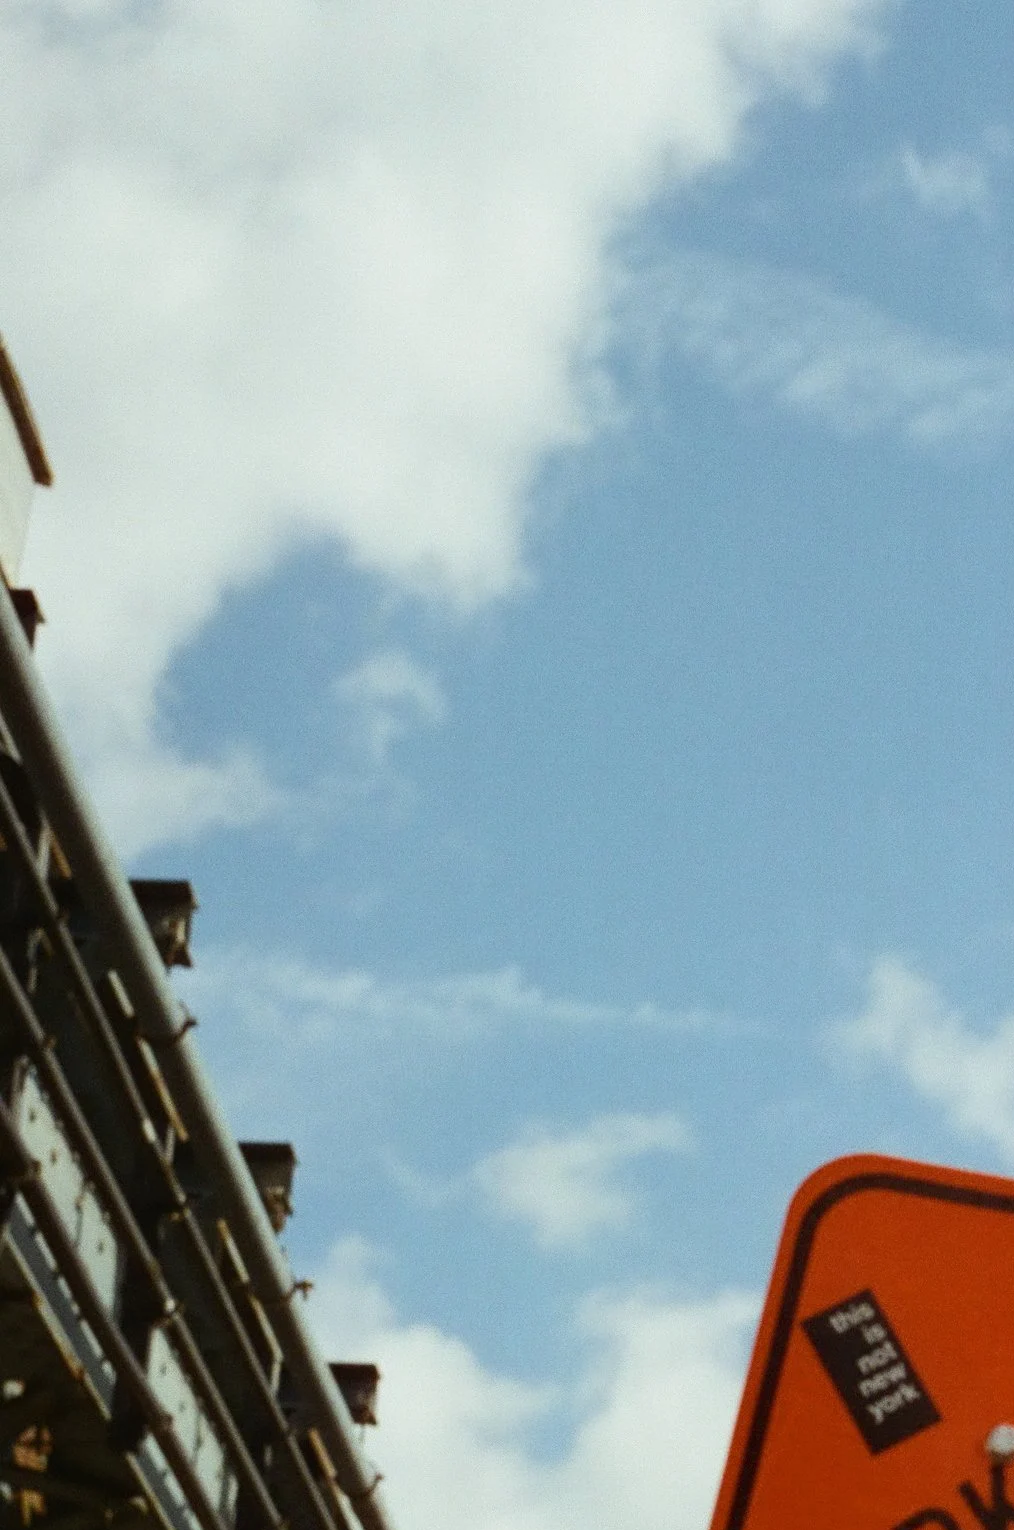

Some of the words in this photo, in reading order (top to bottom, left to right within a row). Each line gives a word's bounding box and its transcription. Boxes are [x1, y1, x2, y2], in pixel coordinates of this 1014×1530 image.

[829, 1302, 876, 1334] this
[863, 1322, 888, 1345] is
[857, 1341, 898, 1375] not
[858, 1363, 907, 1397] new
[865, 1384, 920, 1425] york
